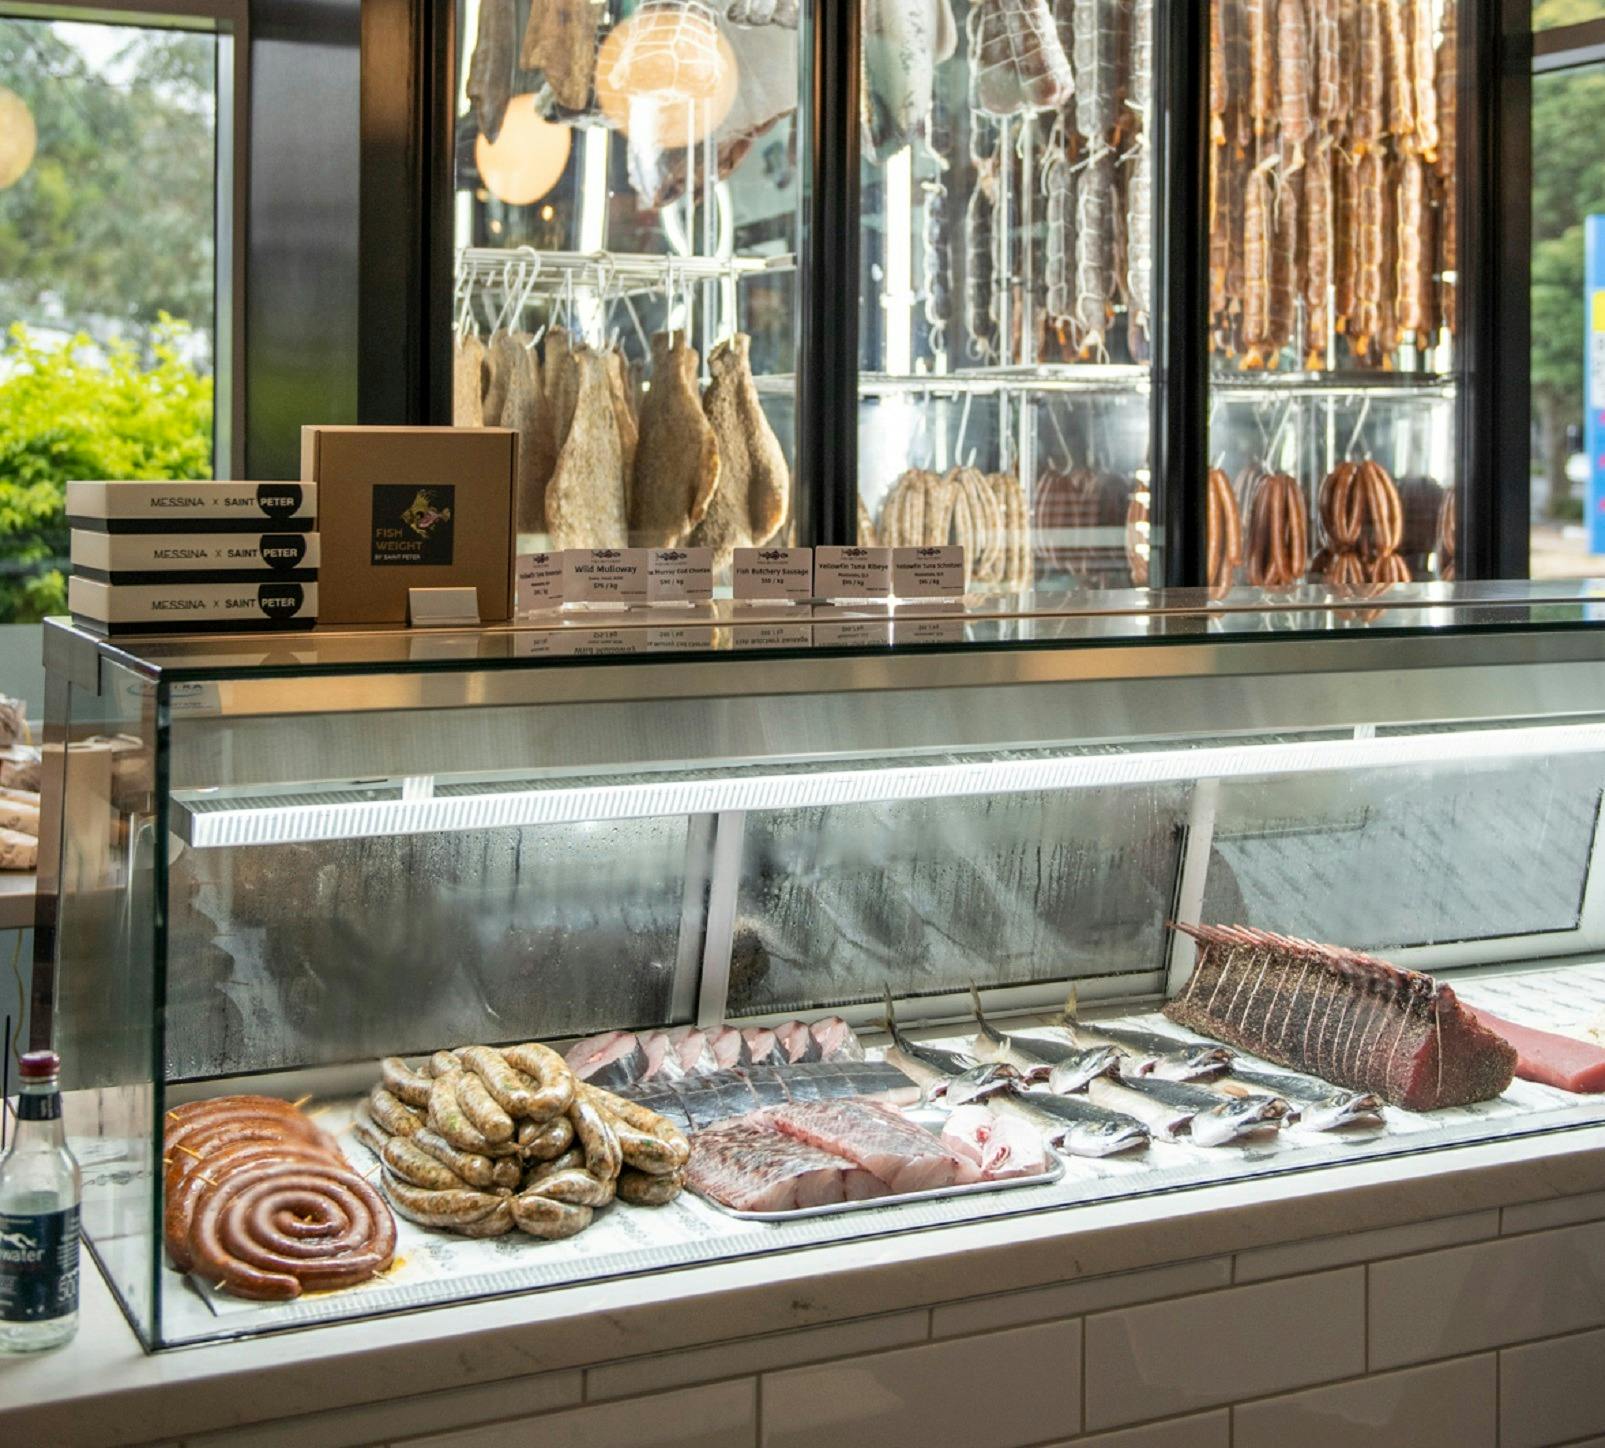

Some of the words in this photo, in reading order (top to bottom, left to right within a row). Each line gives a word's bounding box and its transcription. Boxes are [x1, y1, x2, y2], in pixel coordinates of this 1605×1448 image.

[150, 498, 205, 508] MESSINA
[224, 498, 257, 507] SAINT
[260, 497, 295, 507] PETER
[376, 528, 403, 538] FISH
[376, 541, 423, 551] WEIGHT
[153, 549, 208, 559] MESSINA
[227, 549, 258, 558] SAINT
[263, 548, 298, 558] PETER
[575, 565, 594, 573] Wild
[596, 565, 637, 575] Mulloway
[751, 568, 781, 576] Butchery
[782, 568, 809, 576] Sausage
[152, 600, 206, 610] MESSINA
[225, 599, 257, 608] SAINT
[261, 598, 296, 607] PETER
